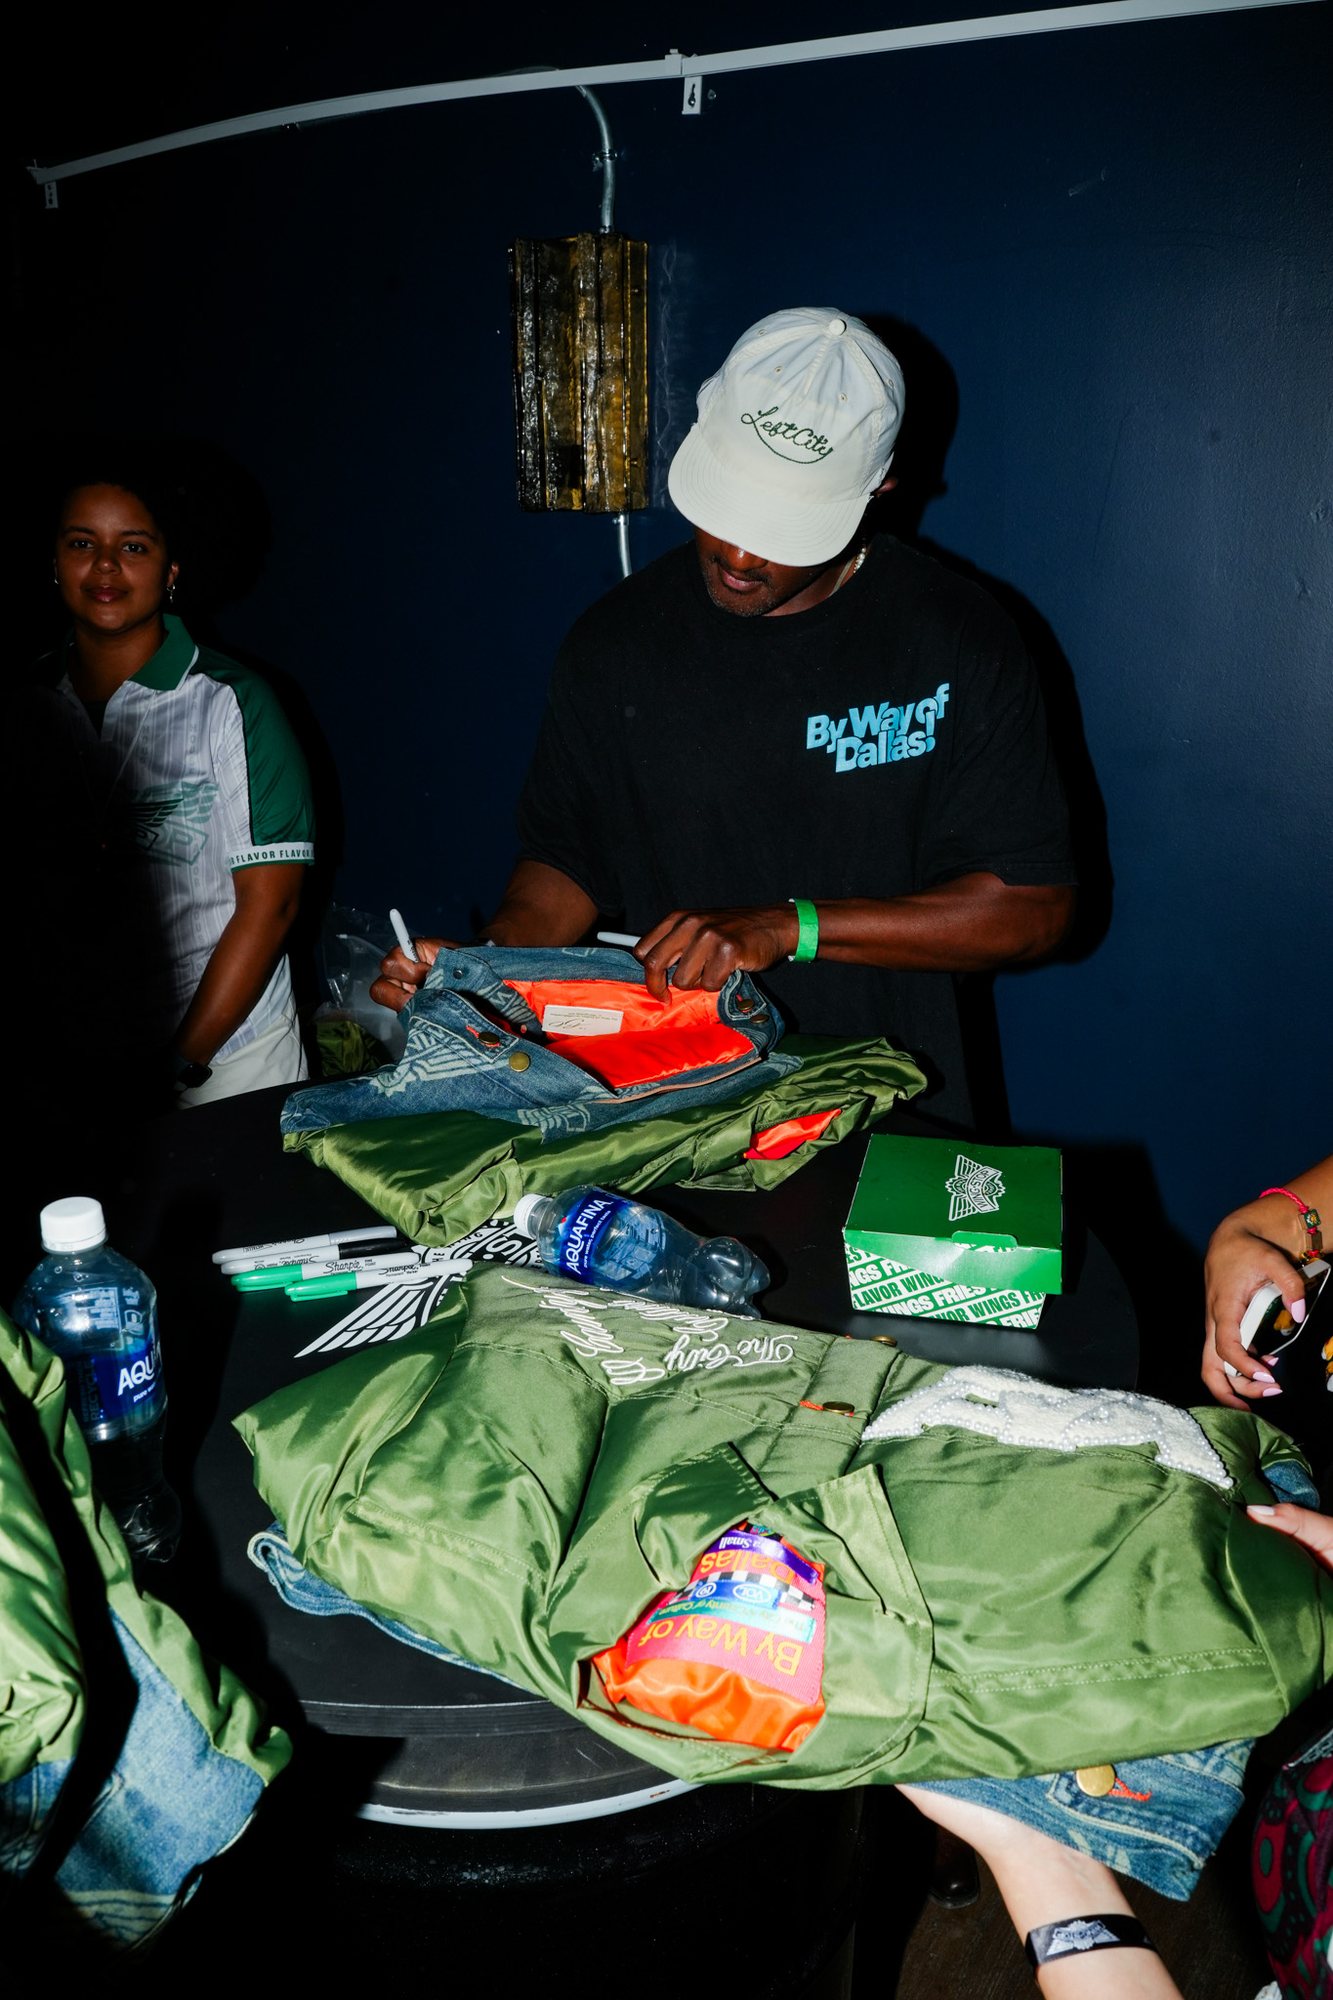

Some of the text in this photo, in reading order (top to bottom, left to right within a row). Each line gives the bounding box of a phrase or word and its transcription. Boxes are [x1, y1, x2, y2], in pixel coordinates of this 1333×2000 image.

[806, 682, 950, 754] By Way of
[236, 850, 276, 863] FLAVOR
[565, 1199, 612, 1275] AQUAFINA
[323, 1260, 363, 1274] Sharpie
[967, 1291, 1020, 1318] WINGS
[664, 1333, 742, 1371] City
[733, 1335, 798, 1367] The
[718, 1536, 752, 1549] Small
[701, 1549, 795, 1585] Dallas
[638, 1614, 804, 1677] By Way of
